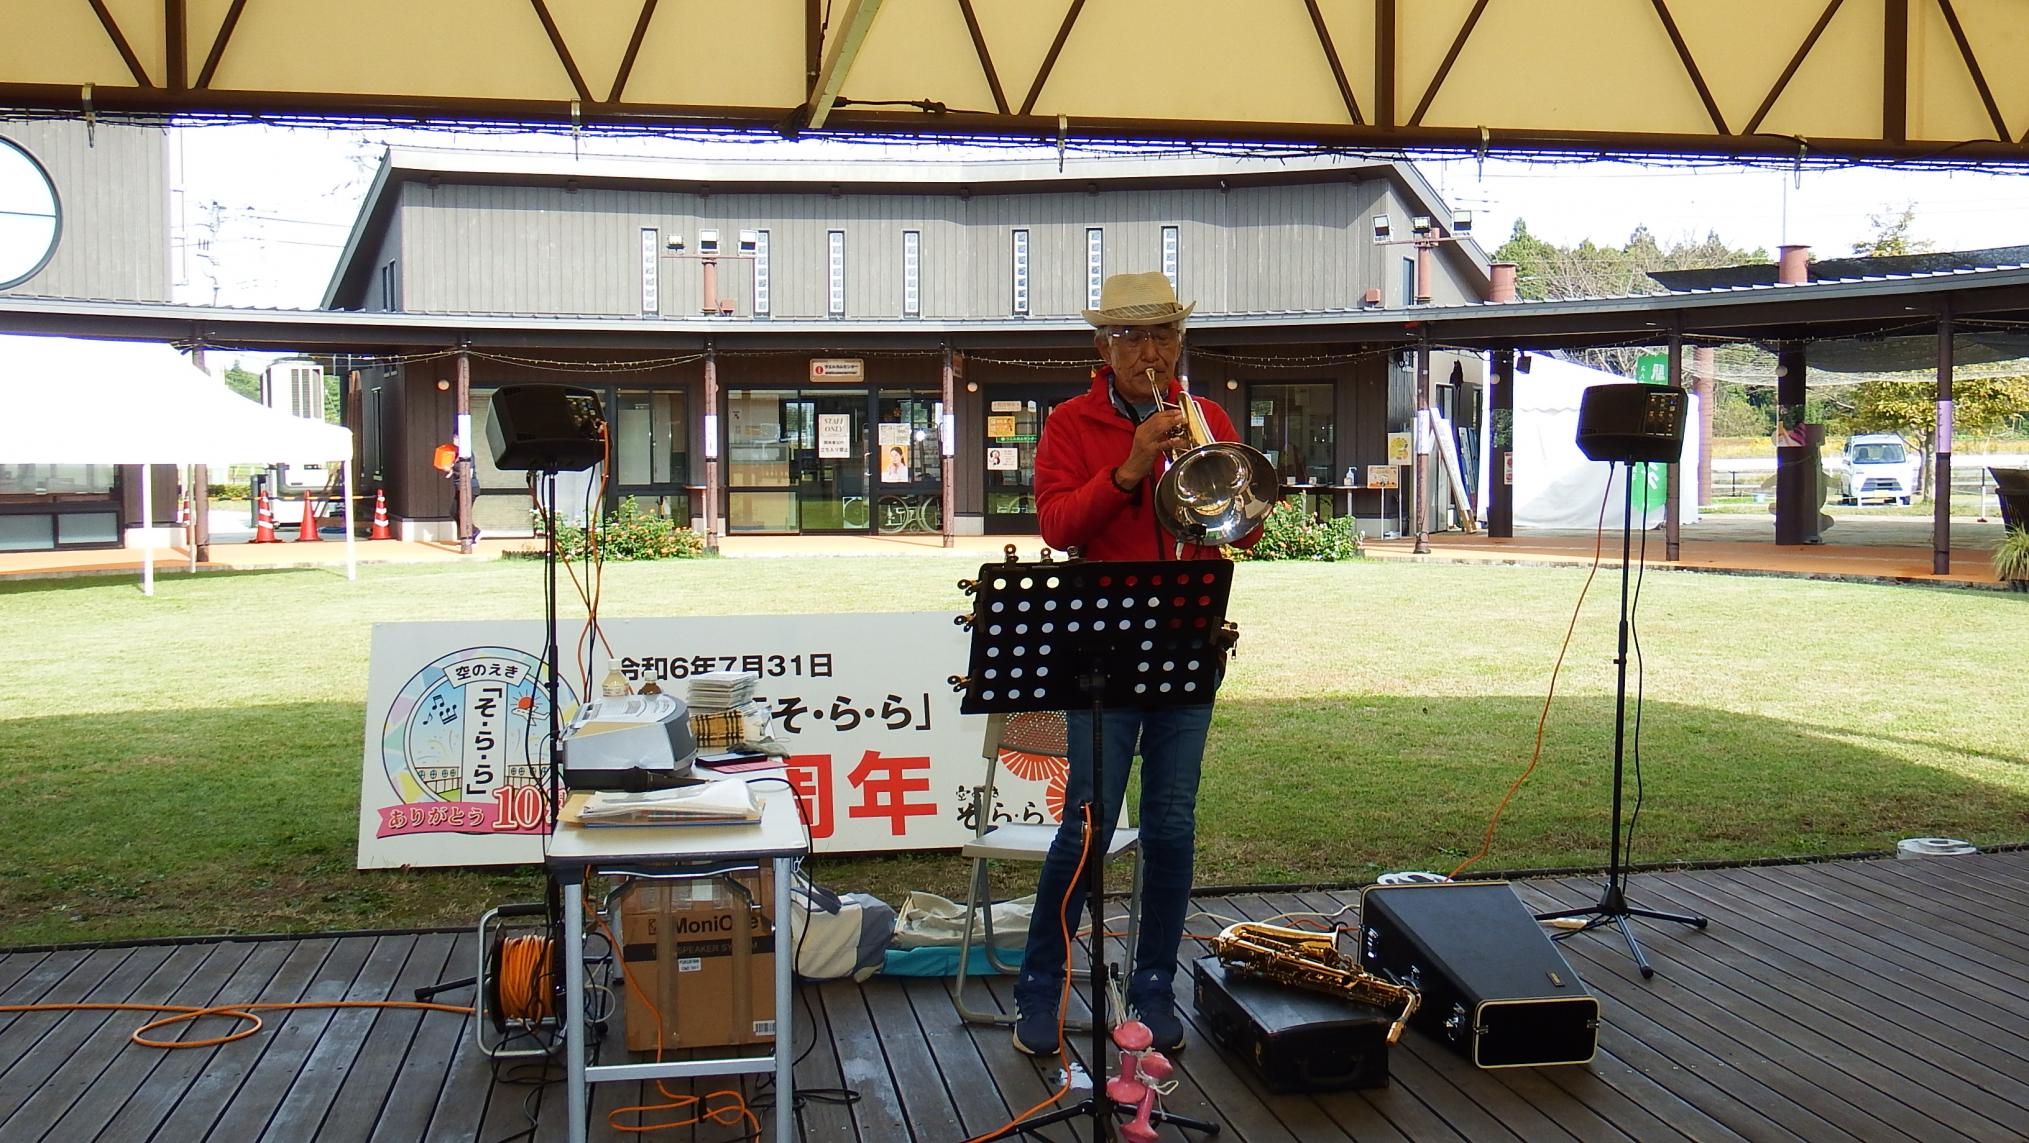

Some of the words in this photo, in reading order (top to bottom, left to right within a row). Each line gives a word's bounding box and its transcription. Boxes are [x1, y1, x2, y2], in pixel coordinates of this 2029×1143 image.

[455, 663, 519, 681] 空のえき
[621, 653, 833, 681] 令和6年7月31日
[466, 687, 503, 795] 「そ・ら・ら」
[388, 807, 485, 829] ありがとう
